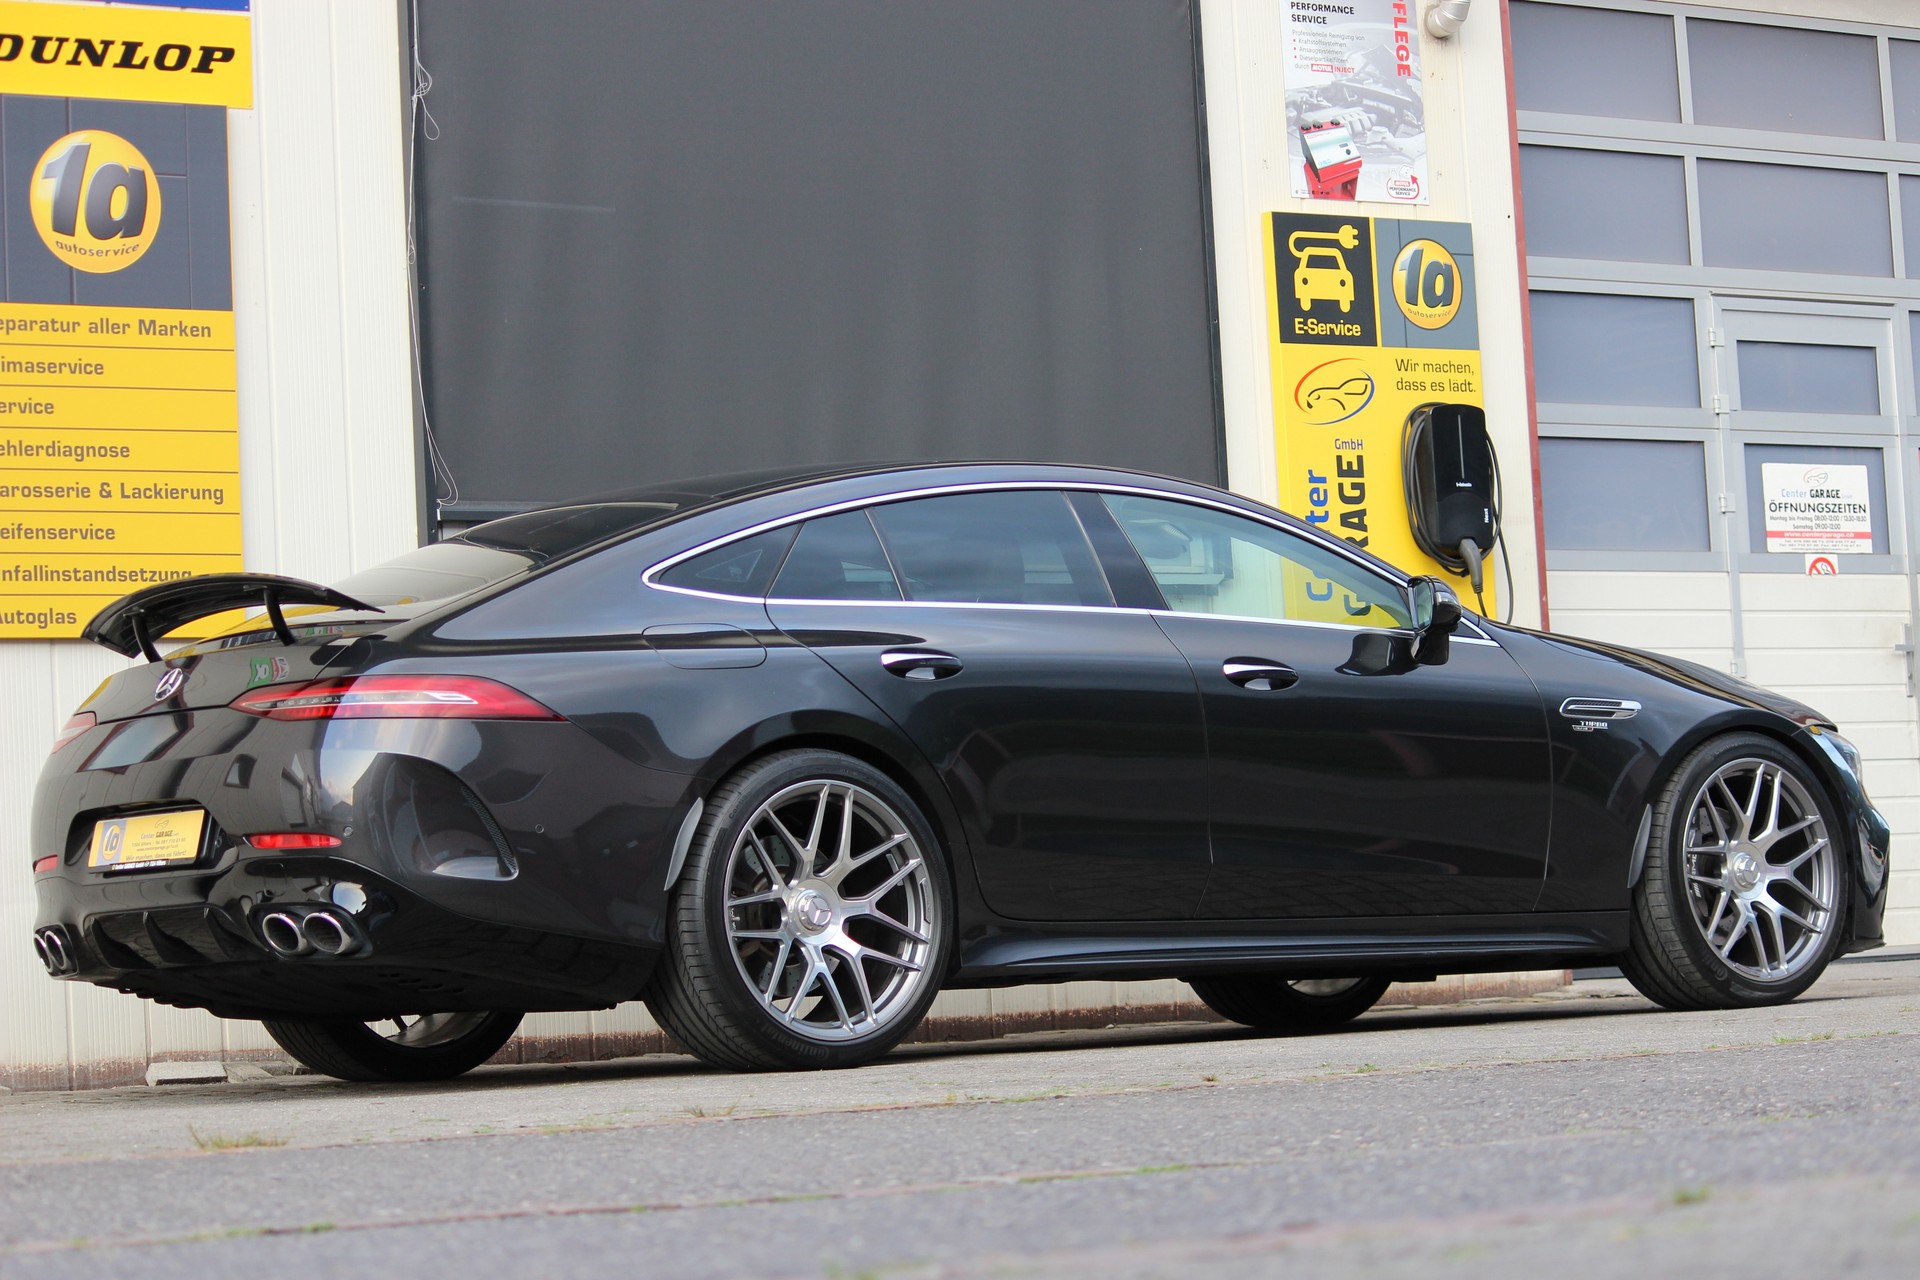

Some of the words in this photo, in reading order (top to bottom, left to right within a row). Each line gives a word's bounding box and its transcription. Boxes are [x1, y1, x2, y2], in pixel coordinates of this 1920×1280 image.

[1290, 1, 1355, 15] PERFORMANCE
[1291, 13, 1328, 25] SERVICE
[1328, 32, 1355, 42] Reinigung
[1392, 0, 1412, 77] FLEGE
[0, 33, 236, 74] DUNLOP
[1334, 66, 1356, 74] INJECT
[41, 141, 148, 240] 1a
[54, 239, 140, 258] autoservice
[1398, 247, 1455, 309] 1a
[1407, 308, 1453, 319] autoservice
[88, 318, 131, 335] aller
[138, 319, 212, 338] Marken
[1294, 317, 1362, 337] E-Service
[1395, 358, 1419, 372] Wir
[1422, 360, 1475, 376] machen,
[1396, 377, 1427, 392] dass
[1429, 380, 1446, 393] es
[1448, 378, 1477, 393] lädt.
[1334, 438, 1364, 451] GmbH
[98, 482, 113, 499] &
[119, 482, 225, 505] Lackierung
[1781, 488, 1807, 498] Center
[1809, 488, 1841, 499] GARAGE
[1768, 499, 1867, 514] ÖFFNUNGSZEITEN
